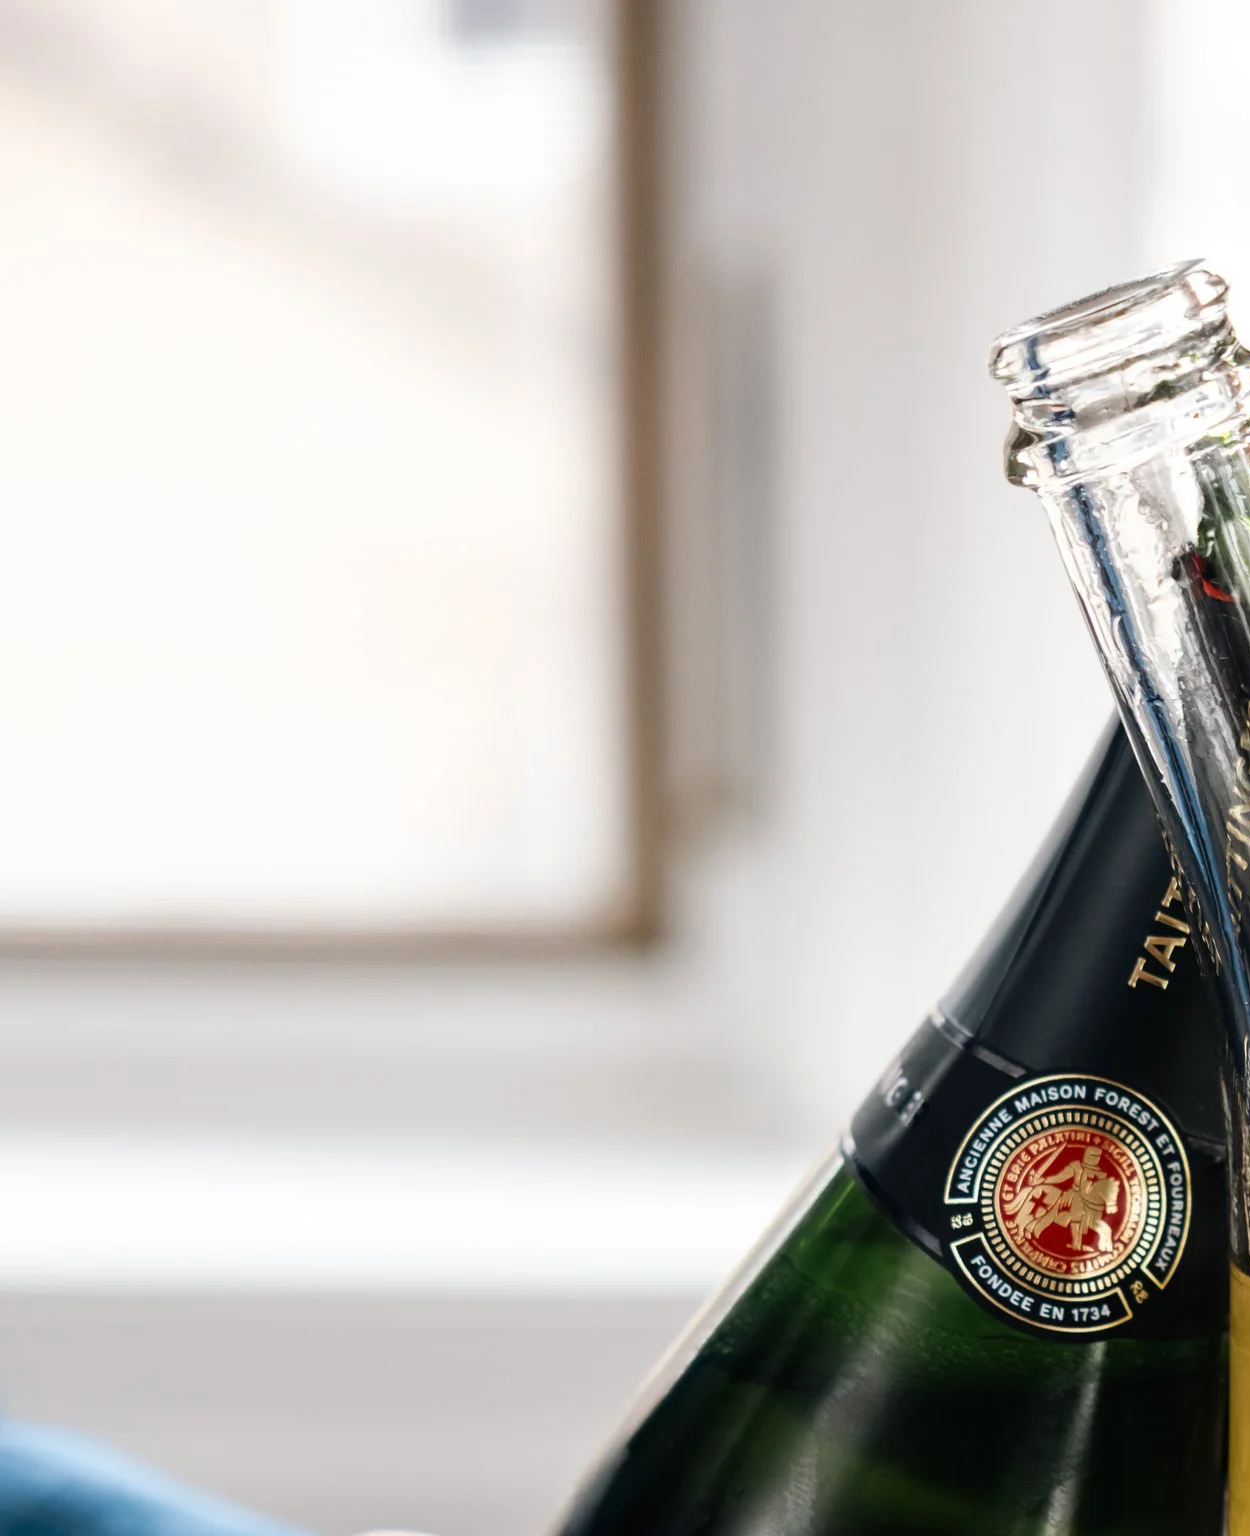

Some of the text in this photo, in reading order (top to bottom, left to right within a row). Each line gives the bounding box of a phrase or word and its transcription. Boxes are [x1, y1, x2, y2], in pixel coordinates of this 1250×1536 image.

[956, 1084, 1185, 1272] ANCIENNE MAISON FOREST ET FOURNEAUX
[970, 1254, 1111, 1322] FONDEE EN 1734
